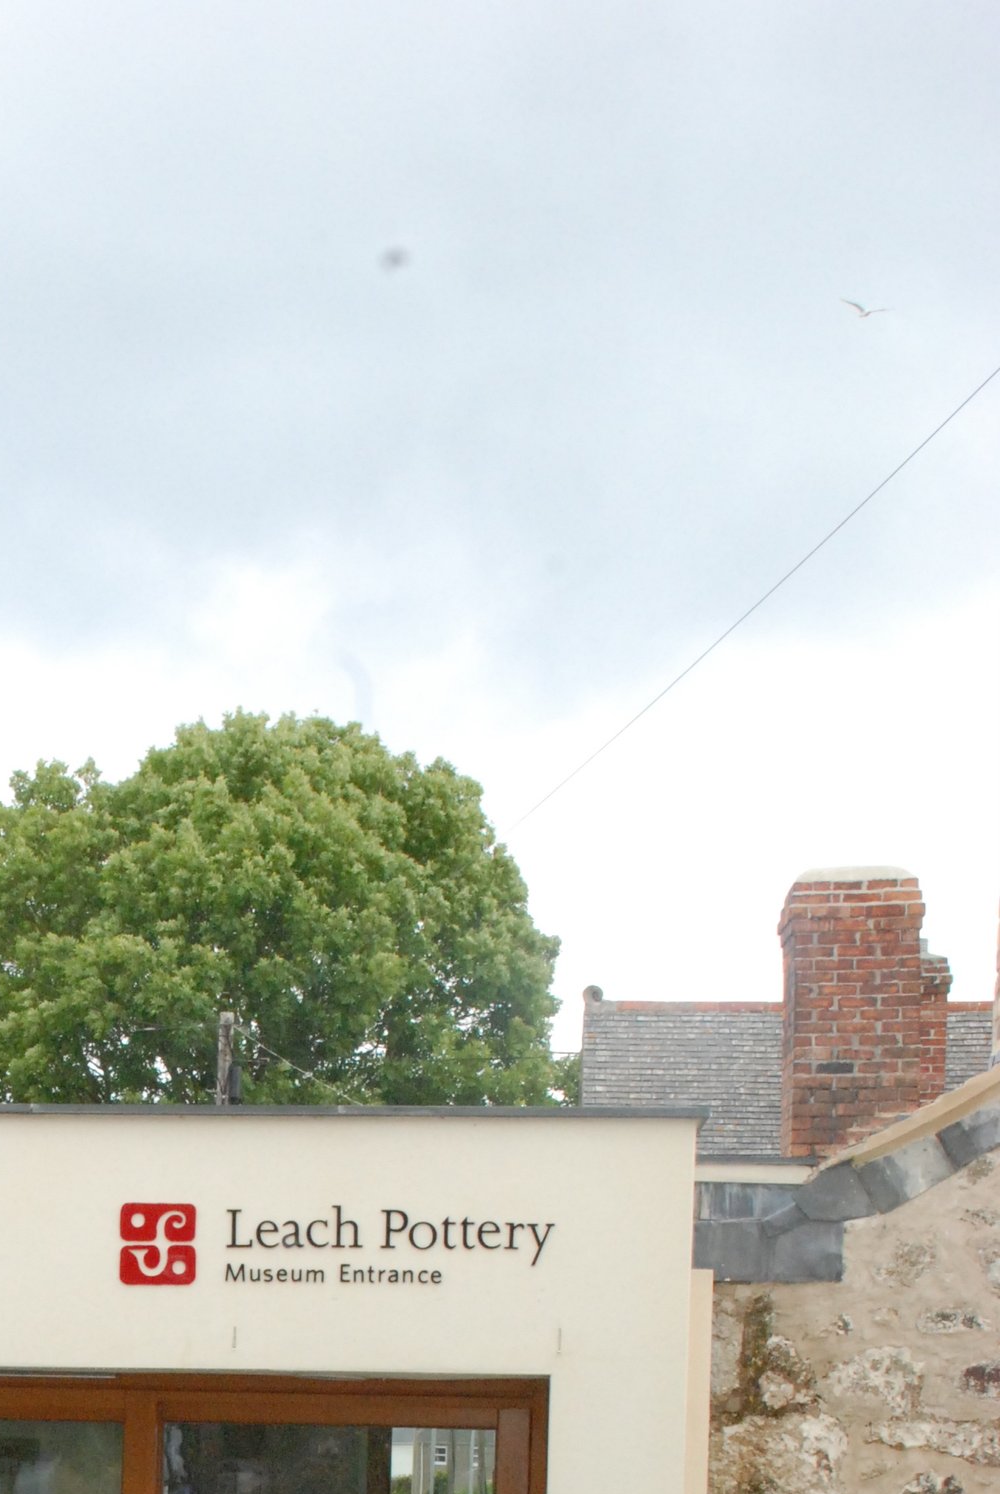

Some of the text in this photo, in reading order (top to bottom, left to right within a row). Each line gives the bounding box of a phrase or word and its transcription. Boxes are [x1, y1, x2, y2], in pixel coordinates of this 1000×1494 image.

[225, 1205, 556, 1267] Leach Pottery
[224, 1263, 443, 1285] Museum Entrance
